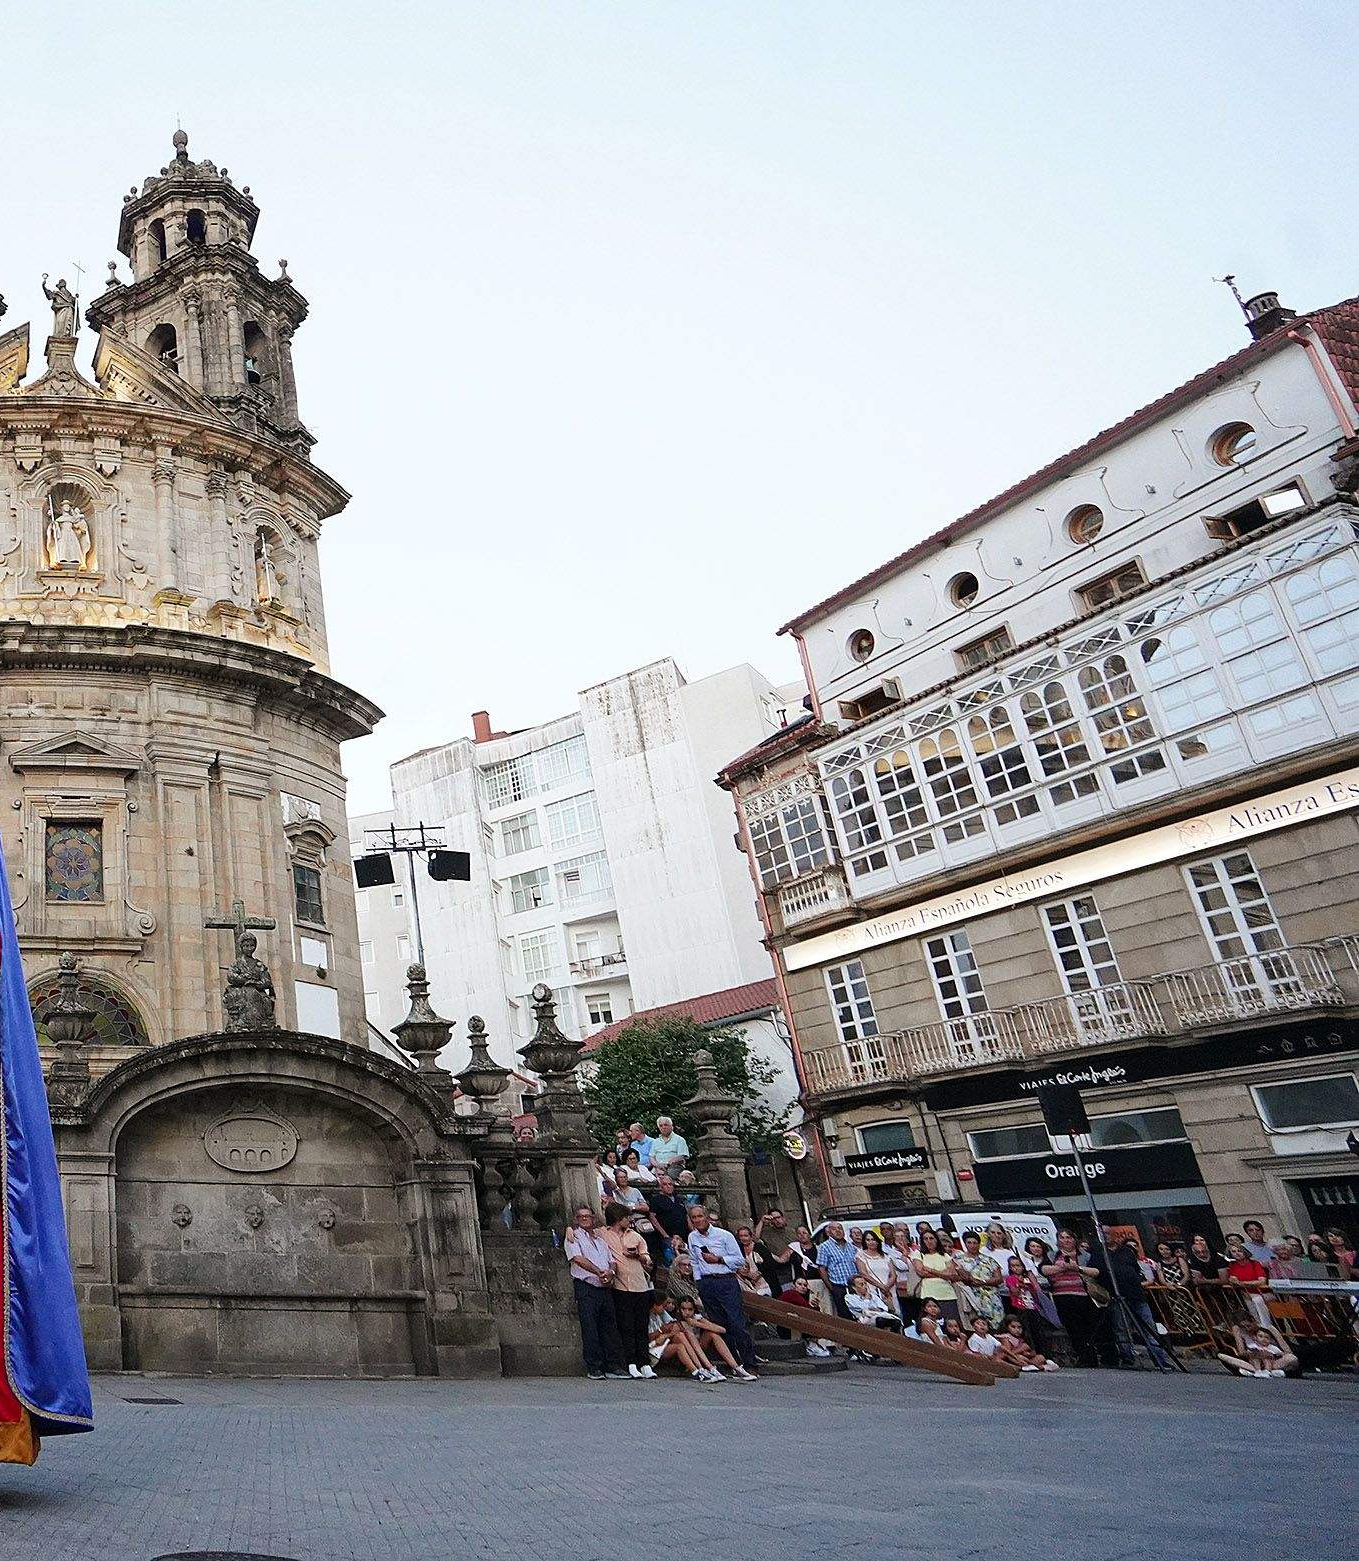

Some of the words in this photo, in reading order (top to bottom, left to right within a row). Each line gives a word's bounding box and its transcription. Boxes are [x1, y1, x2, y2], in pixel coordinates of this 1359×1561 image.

[1229, 796, 1320, 833] Alianza
[863, 916, 916, 940] Alianza
[919, 892, 990, 924] Española
[993, 870, 1064, 900] Seguros
[848, 1160, 873, 1168] VIAJES
[1006, 1225, 1049, 1235] SONIDO
